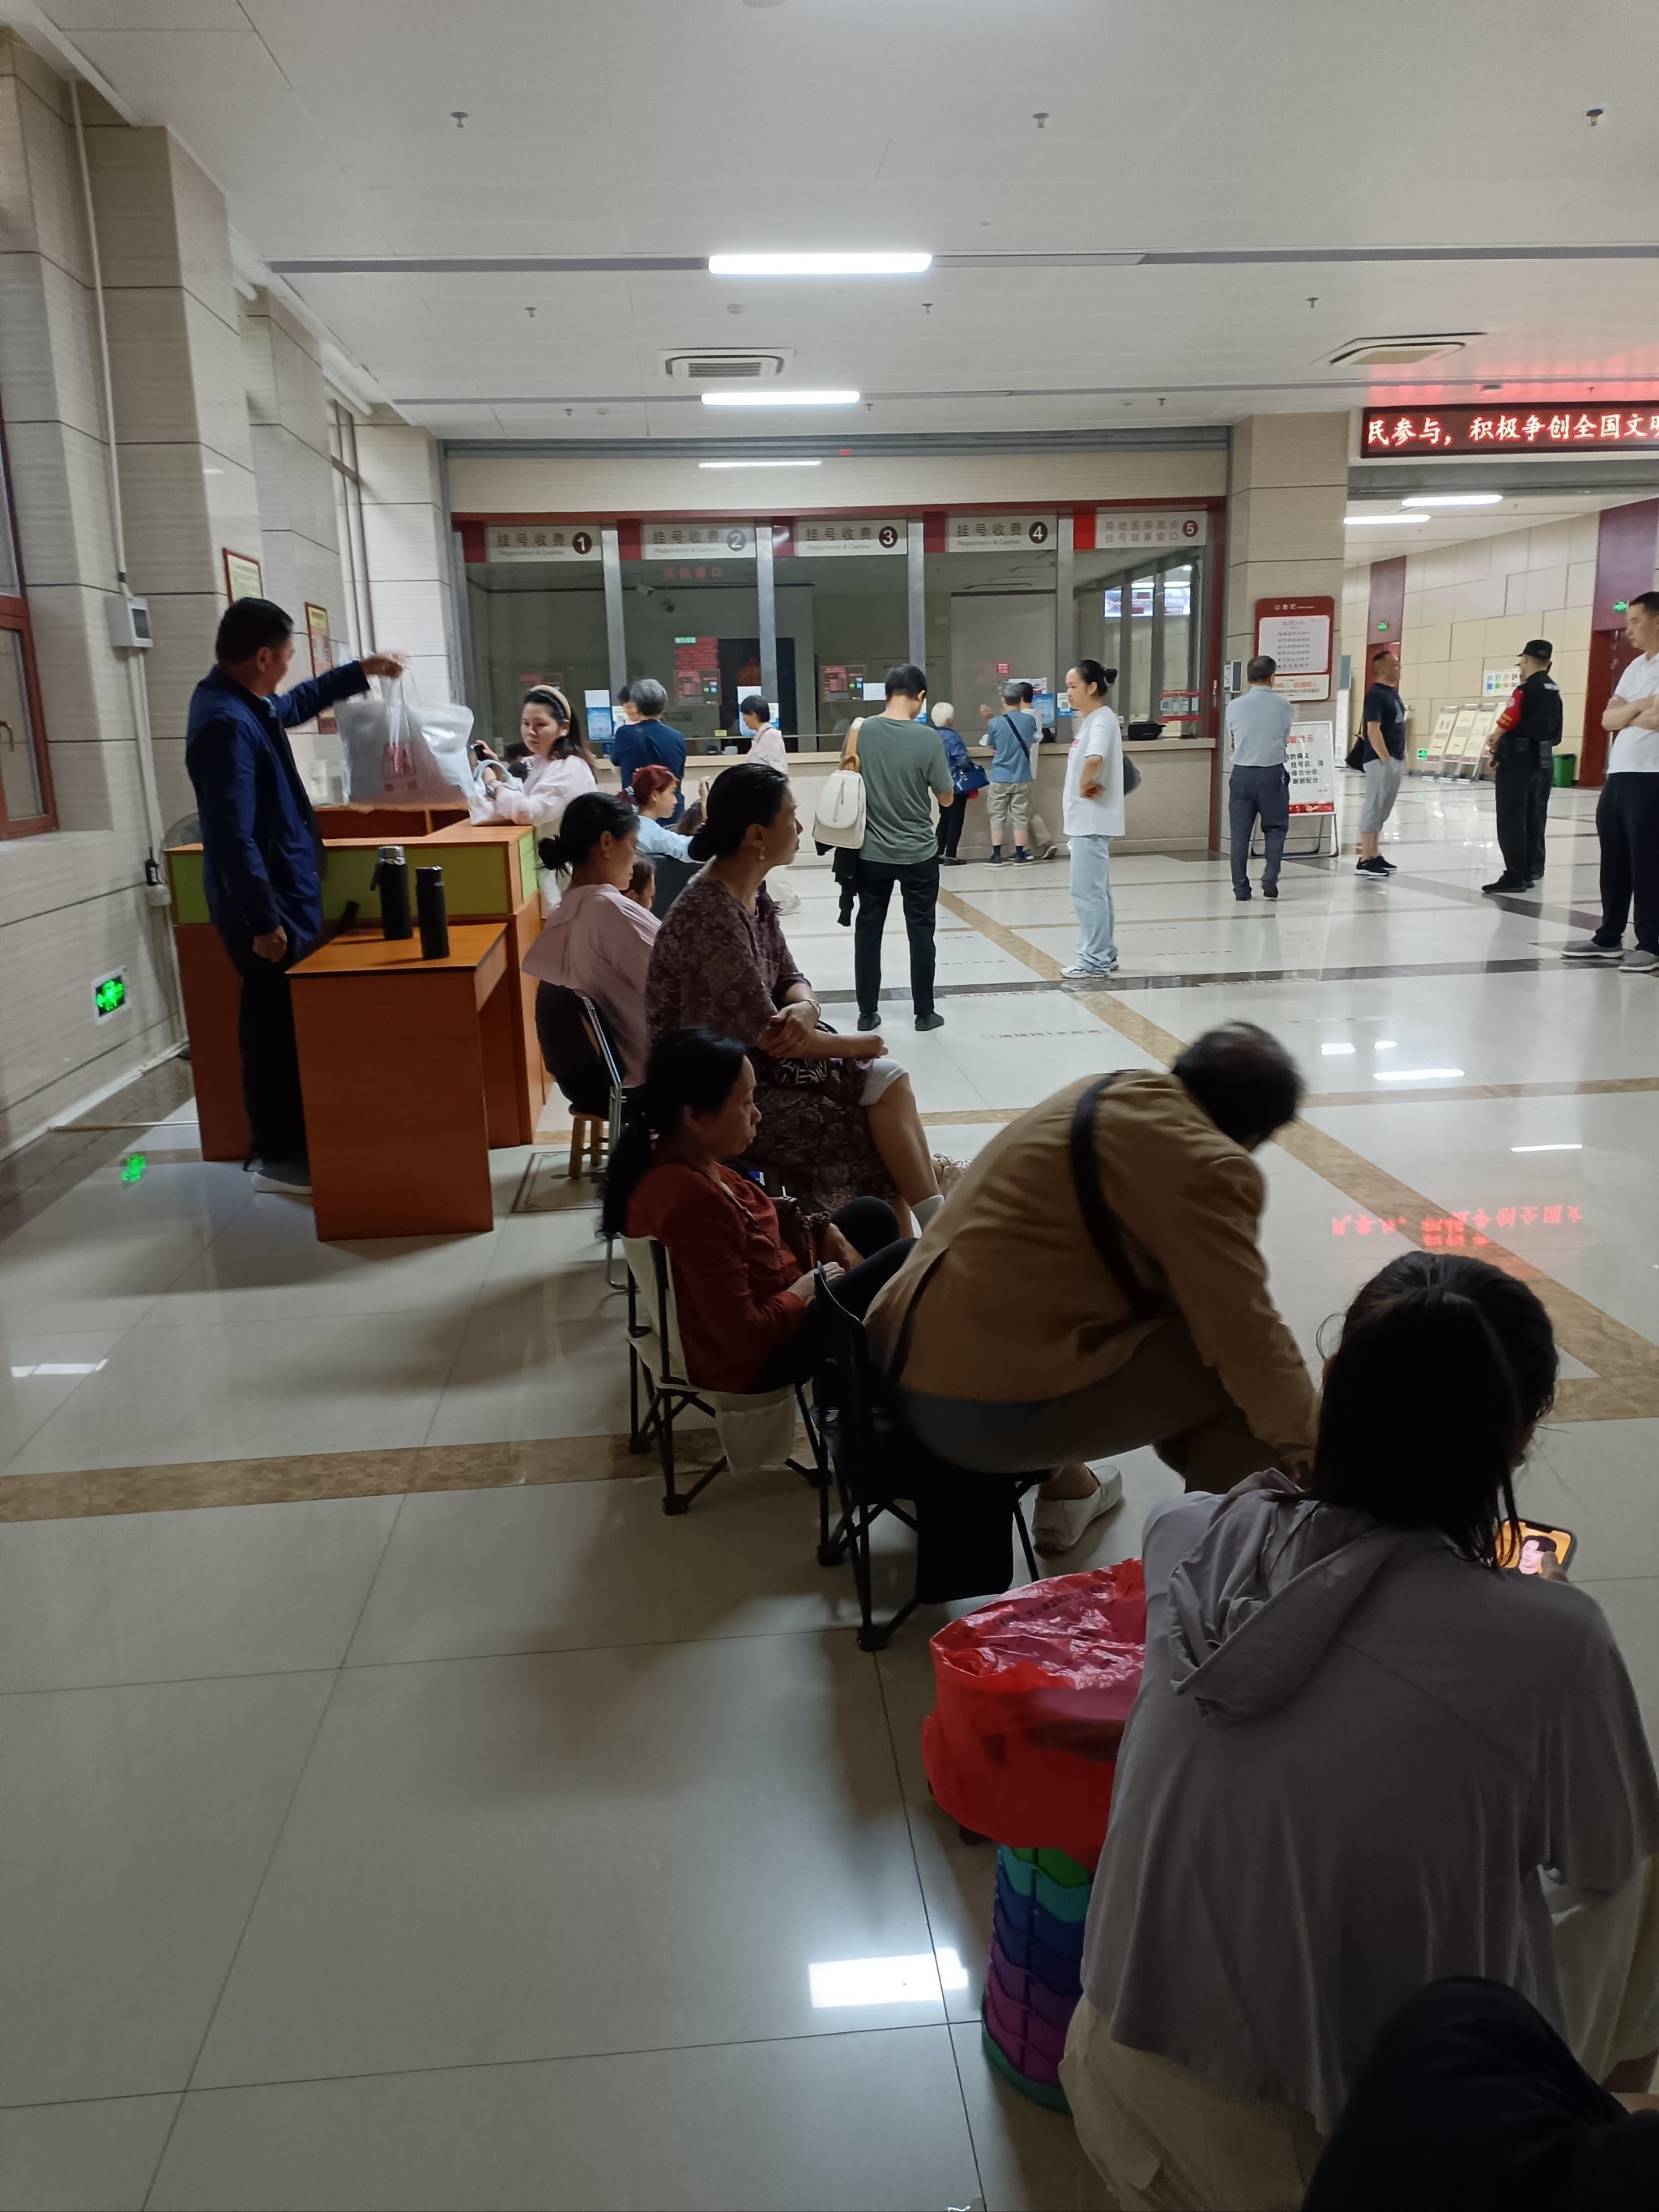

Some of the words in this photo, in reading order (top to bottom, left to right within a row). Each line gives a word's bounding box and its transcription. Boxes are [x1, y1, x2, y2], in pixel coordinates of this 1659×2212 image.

[806, 527, 872, 541] 挂号收费
[883, 530, 893, 544] 3
[957, 522, 1022, 537] 挂号收费
[1033, 526, 1043, 539] 4
[1187, 523, 1194, 534] 5
[497, 533, 565, 547] 挂号收费
[577, 537, 586, 551] 1
[653, 531, 719, 543] 挂号收费
[730, 533, 742, 548] 2
